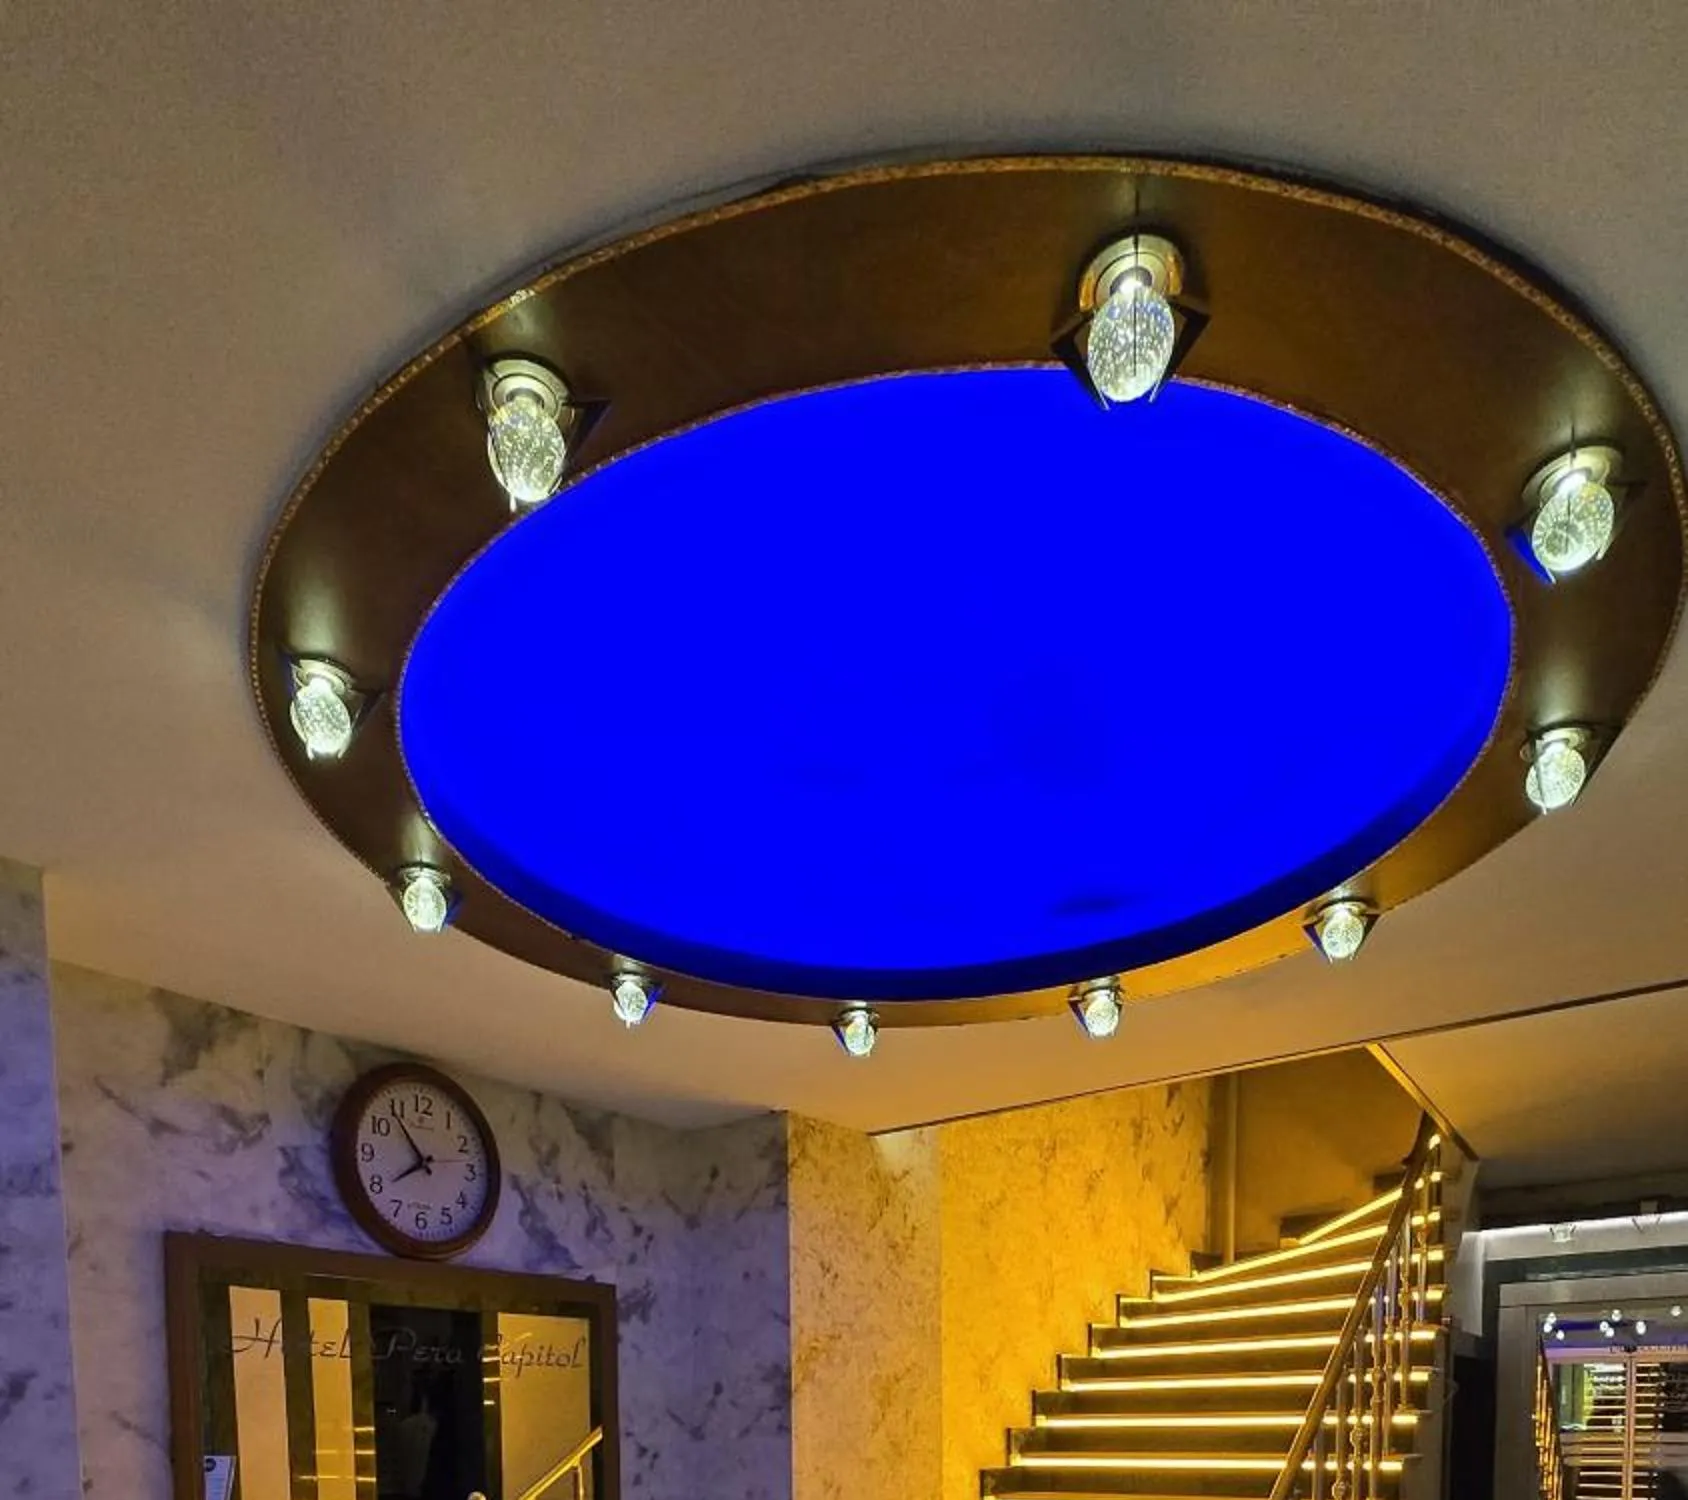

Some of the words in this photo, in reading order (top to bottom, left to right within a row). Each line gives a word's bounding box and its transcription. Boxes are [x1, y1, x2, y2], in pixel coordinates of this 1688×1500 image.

[390, 1098, 405, 1119] 11
[414, 1094, 433, 1116] 12
[371, 1115, 391, 1137] 10
[445, 1112, 451, 1130] 1
[361, 1142, 374, 1162] 9
[456, 1135, 468, 1153] 2
[464, 1164, 476, 1182] 3
[369, 1175, 383, 1194] 8
[390, 1200, 402, 1218] 7
[455, 1191, 467, 1209] 4
[415, 1211, 428, 1230] 6
[440, 1207, 453, 1225] 5
[225, 1317, 353, 1360] Htel
[369, 1326, 465, 1364] Pera
